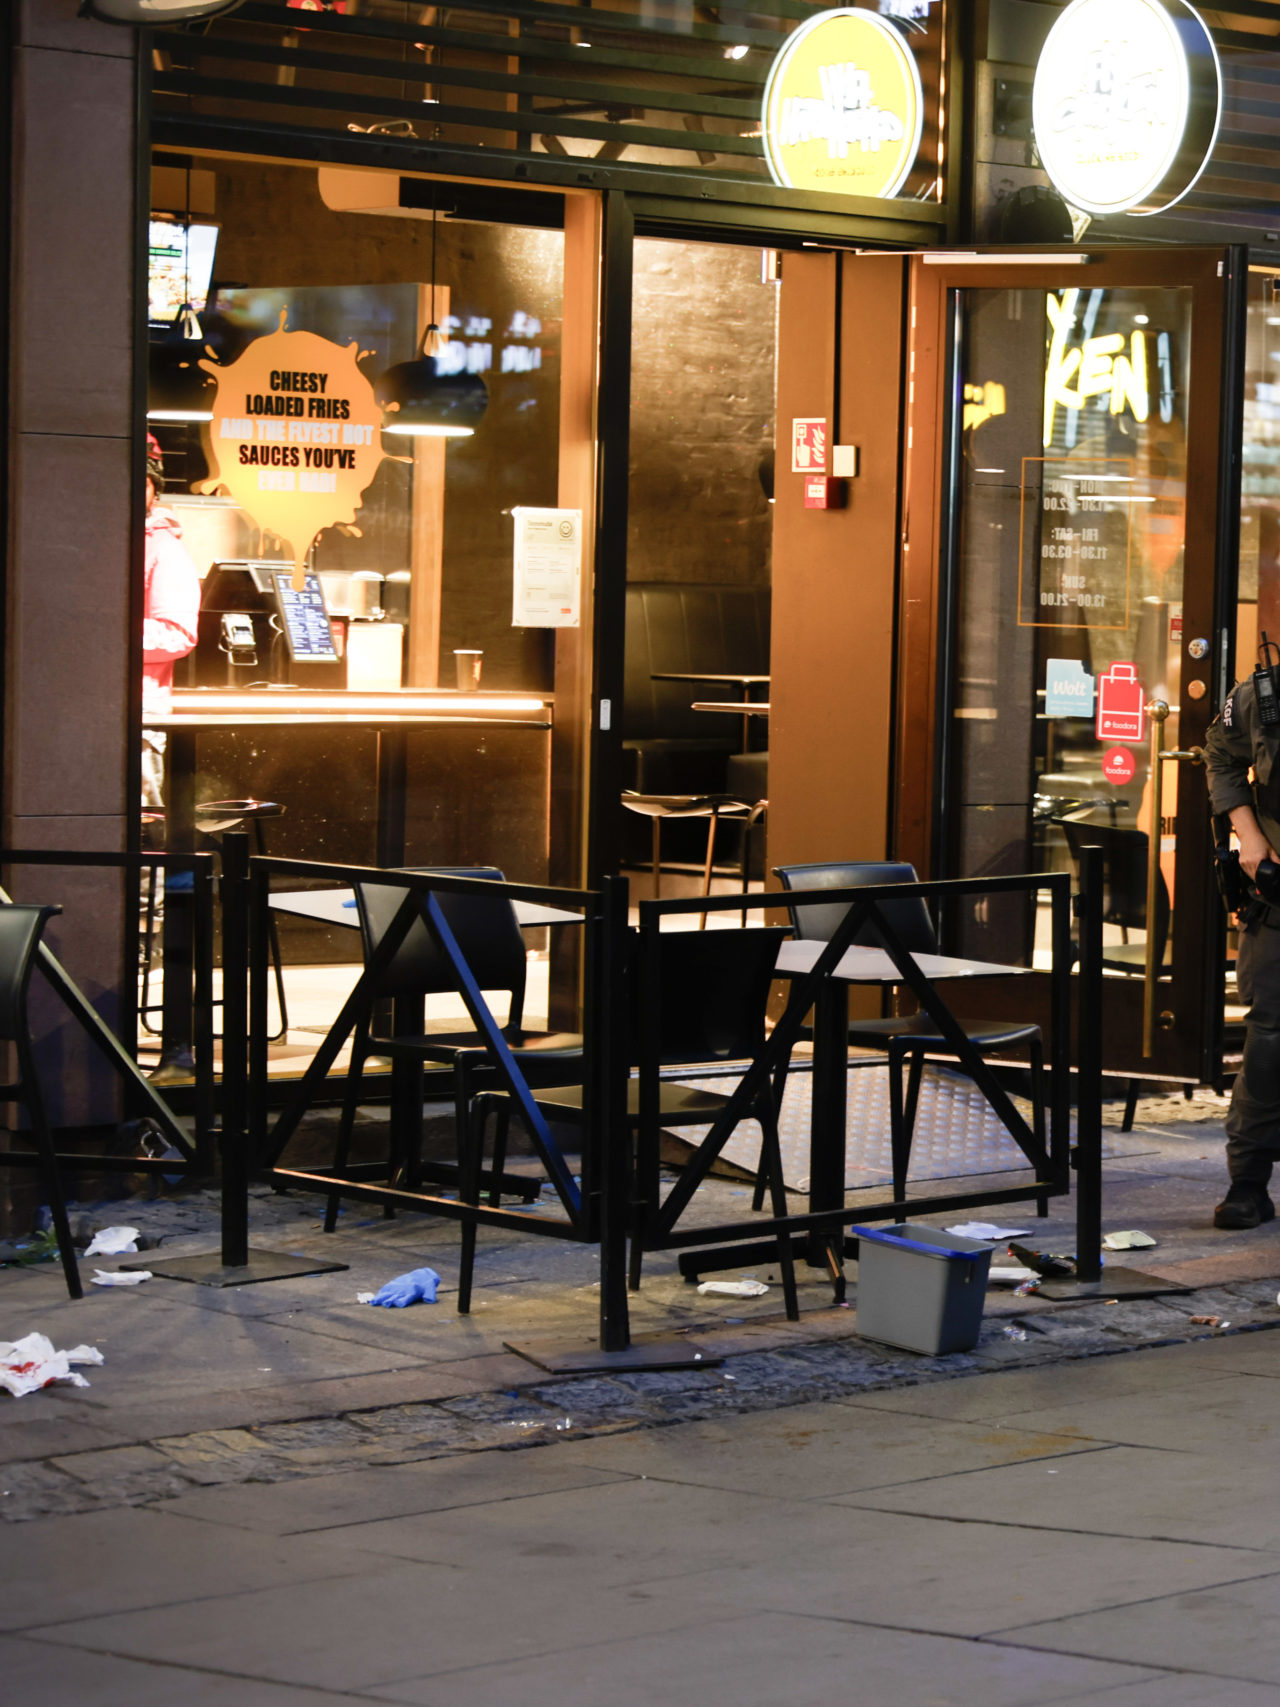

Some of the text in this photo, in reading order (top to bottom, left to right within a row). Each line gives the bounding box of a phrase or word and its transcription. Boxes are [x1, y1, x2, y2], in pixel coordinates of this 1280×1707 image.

[270, 370, 328, 393] CHEESY
[246, 394, 350, 419] LOADED FRIES
[220, 417, 374, 446] AND THE FLYEST HOT
[239, 444, 355, 469] SAUCES YOU'VE
[258, 470, 295, 491] EVER
[1053, 680, 1087, 696] Wolt
[1223, 698, 1233, 727] KGF
[1112, 721, 1137, 730] foodora
[1105, 766, 1131, 775] foodora
